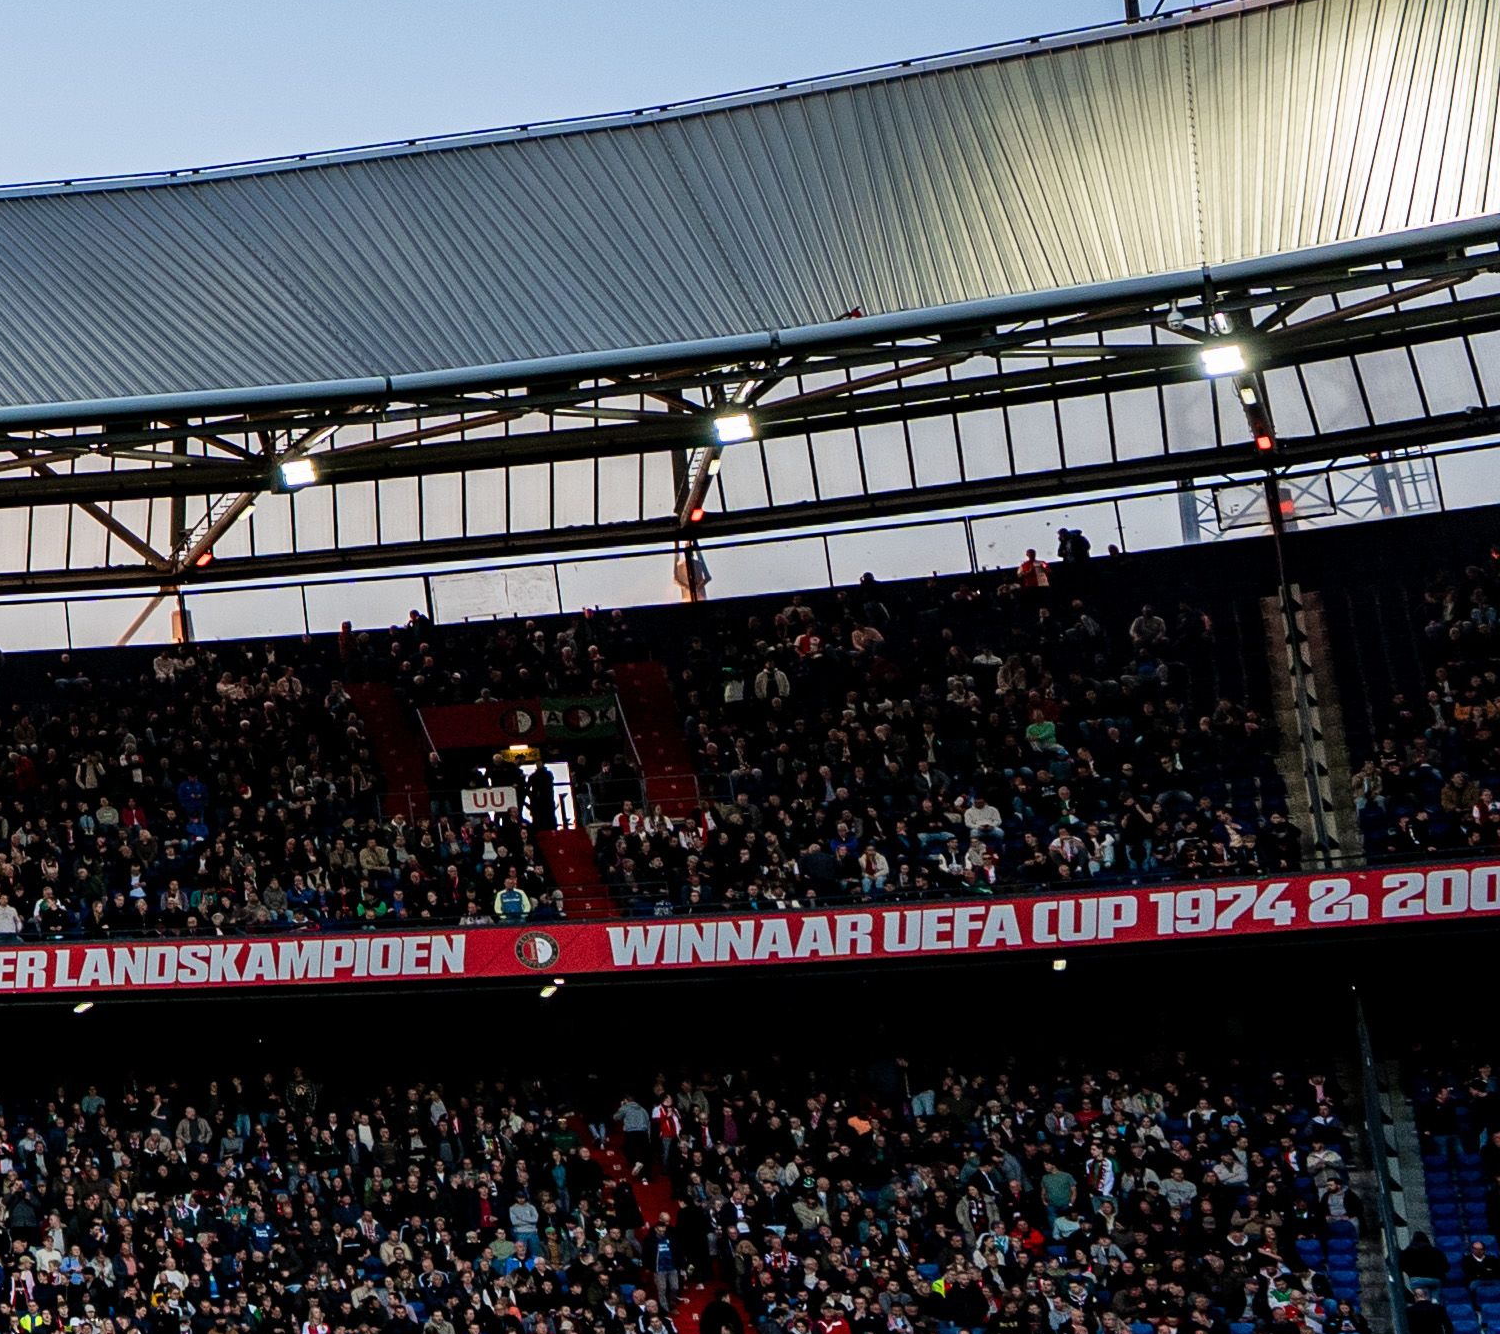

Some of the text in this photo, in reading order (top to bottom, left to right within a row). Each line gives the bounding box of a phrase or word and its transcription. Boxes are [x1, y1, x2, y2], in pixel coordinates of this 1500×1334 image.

[473, 791, 506, 809] UU
[605, 912, 873, 966] WINNAAR
[882, 904, 1023, 953] UEFA
[1032, 895, 1138, 944] CUP
[1149, 882, 1296, 935] 1974
[54, 934, 466, 987] LANDSKAMPIOEN
